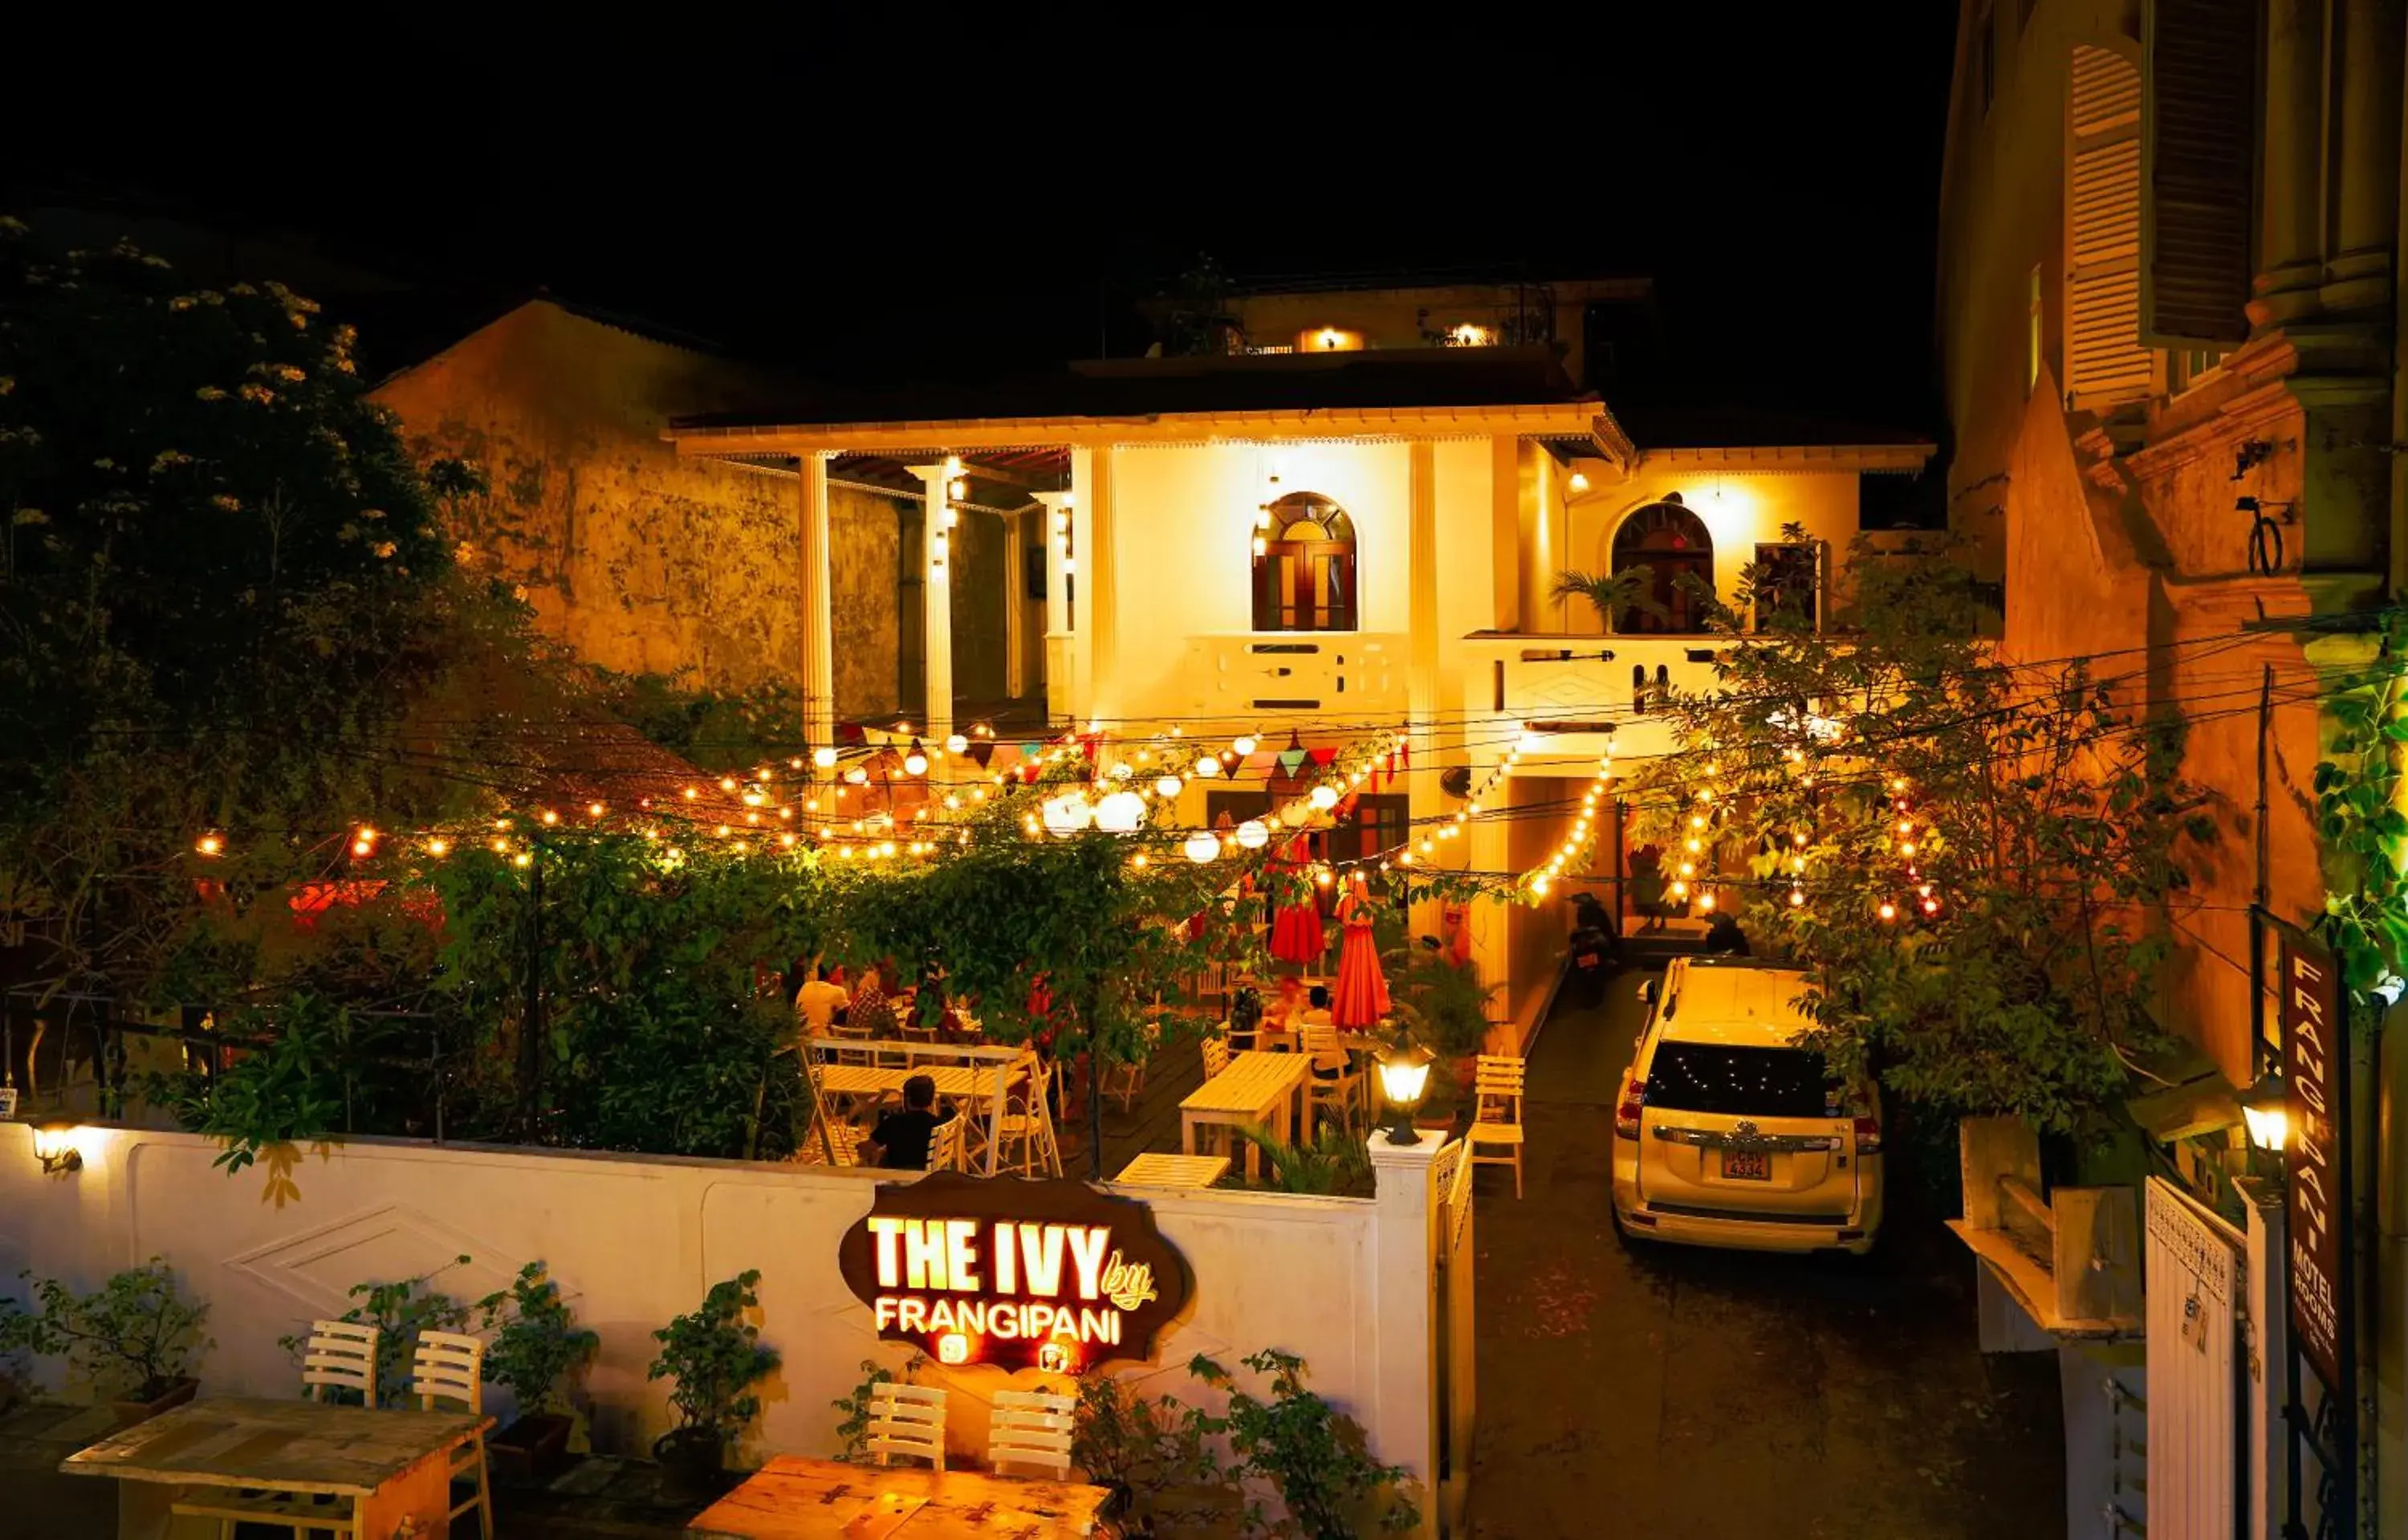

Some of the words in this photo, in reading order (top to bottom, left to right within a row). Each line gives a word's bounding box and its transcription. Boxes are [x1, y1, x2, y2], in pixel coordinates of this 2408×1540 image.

[2293, 955, 2327, 1253] FRANGIPANI
[867, 1216, 980, 1293] THE
[994, 1221, 1111, 1300] IVY
[1100, 1249, 1157, 1311] by
[874, 1296, 1121, 1344] FRANGIPANI
[2295, 1270, 2336, 1340] ROOMS
